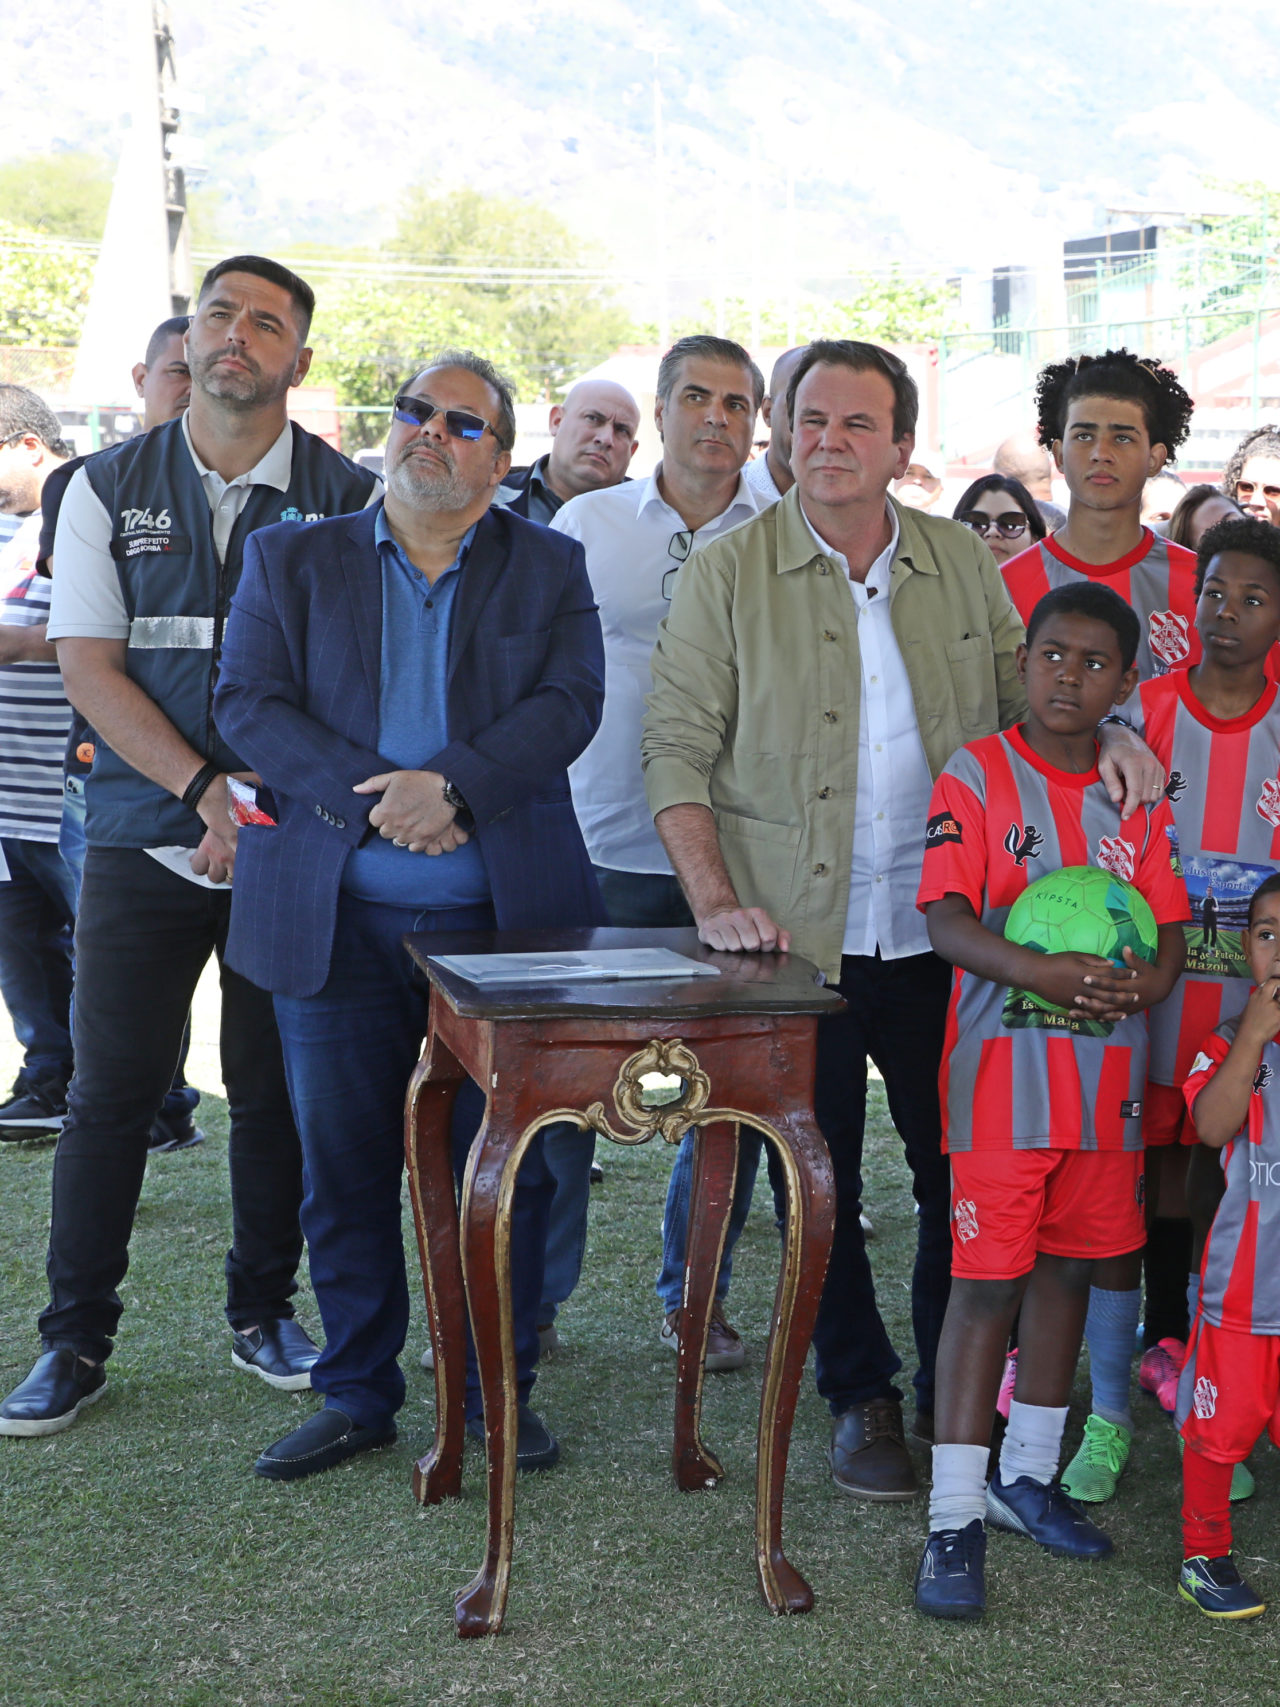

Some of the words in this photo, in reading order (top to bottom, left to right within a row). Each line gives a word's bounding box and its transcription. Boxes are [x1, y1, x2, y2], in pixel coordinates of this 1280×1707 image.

[121, 507, 172, 532] 1746
[1035, 892, 1078, 909] KIPSTA
[1185, 958, 1229, 972] Mazola
